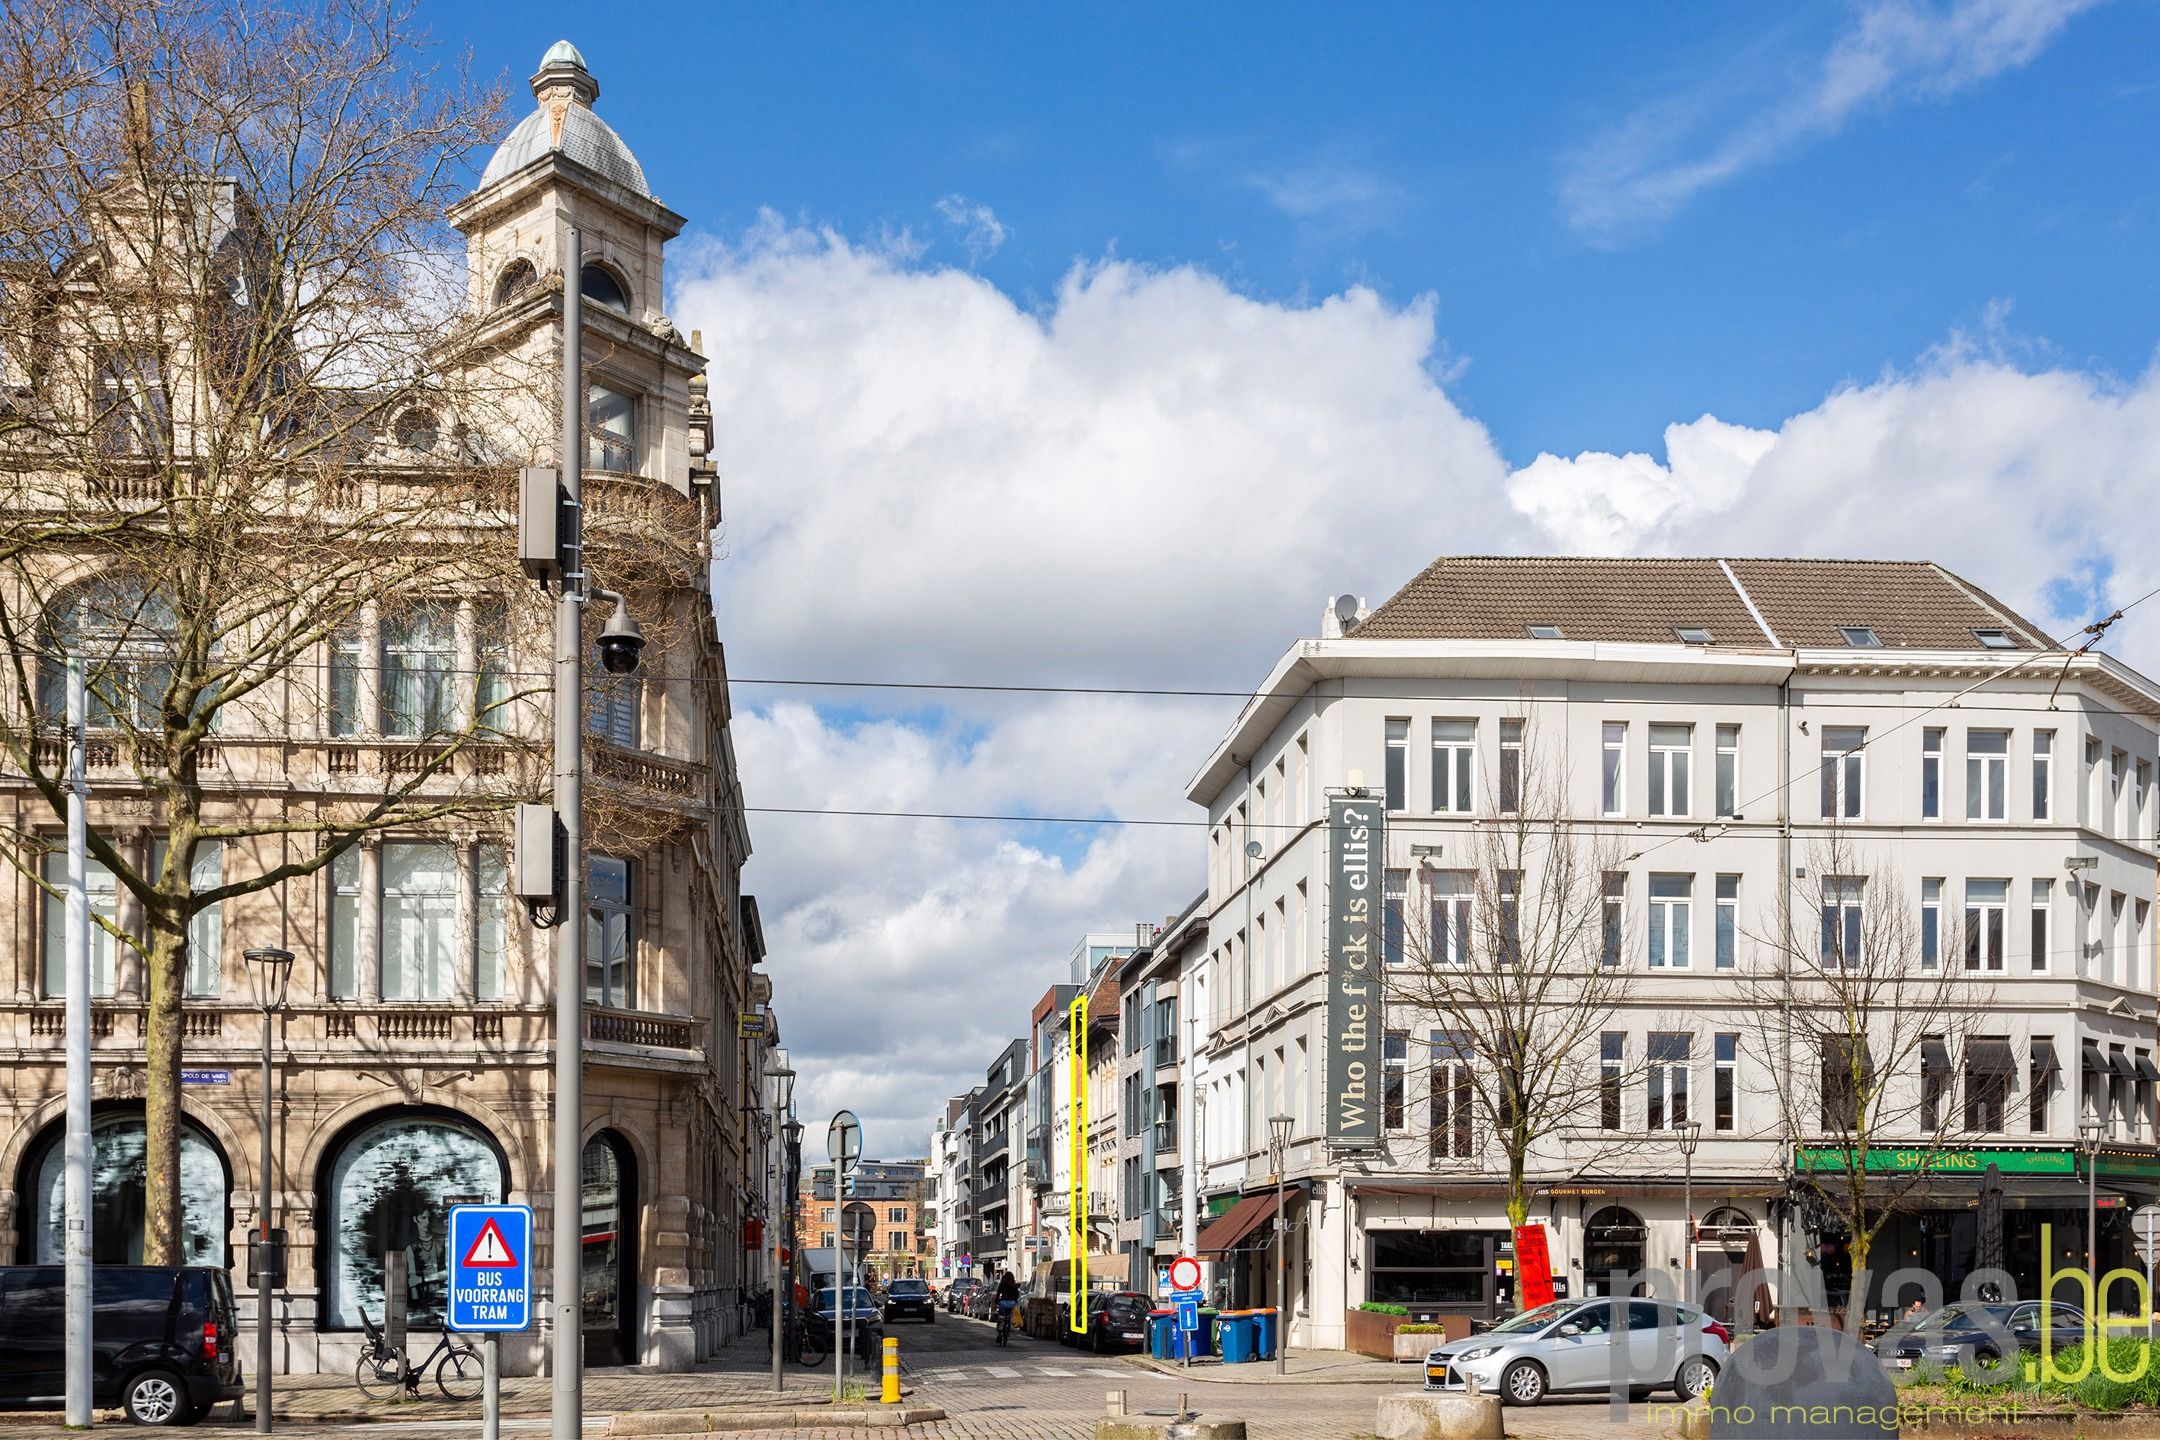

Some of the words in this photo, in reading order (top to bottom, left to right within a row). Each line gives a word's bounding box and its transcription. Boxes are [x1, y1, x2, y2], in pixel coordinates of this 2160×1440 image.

[1343, 808, 1369, 891] ellis?
[1343, 897, 1368, 924] is
[1342, 1004, 1367, 1053] the
[1341, 1061, 1366, 1131] Who
[1896, 1152, 1976, 1169] SHILLING
[2026, 1152, 2065, 1166] SHILLING
[1311, 1183, 1327, 1195] ellis
[477, 1272, 502, 1286] BUS
[456, 1288, 524, 1303] VOORRANG
[472, 1305, 508, 1320] TRAM
